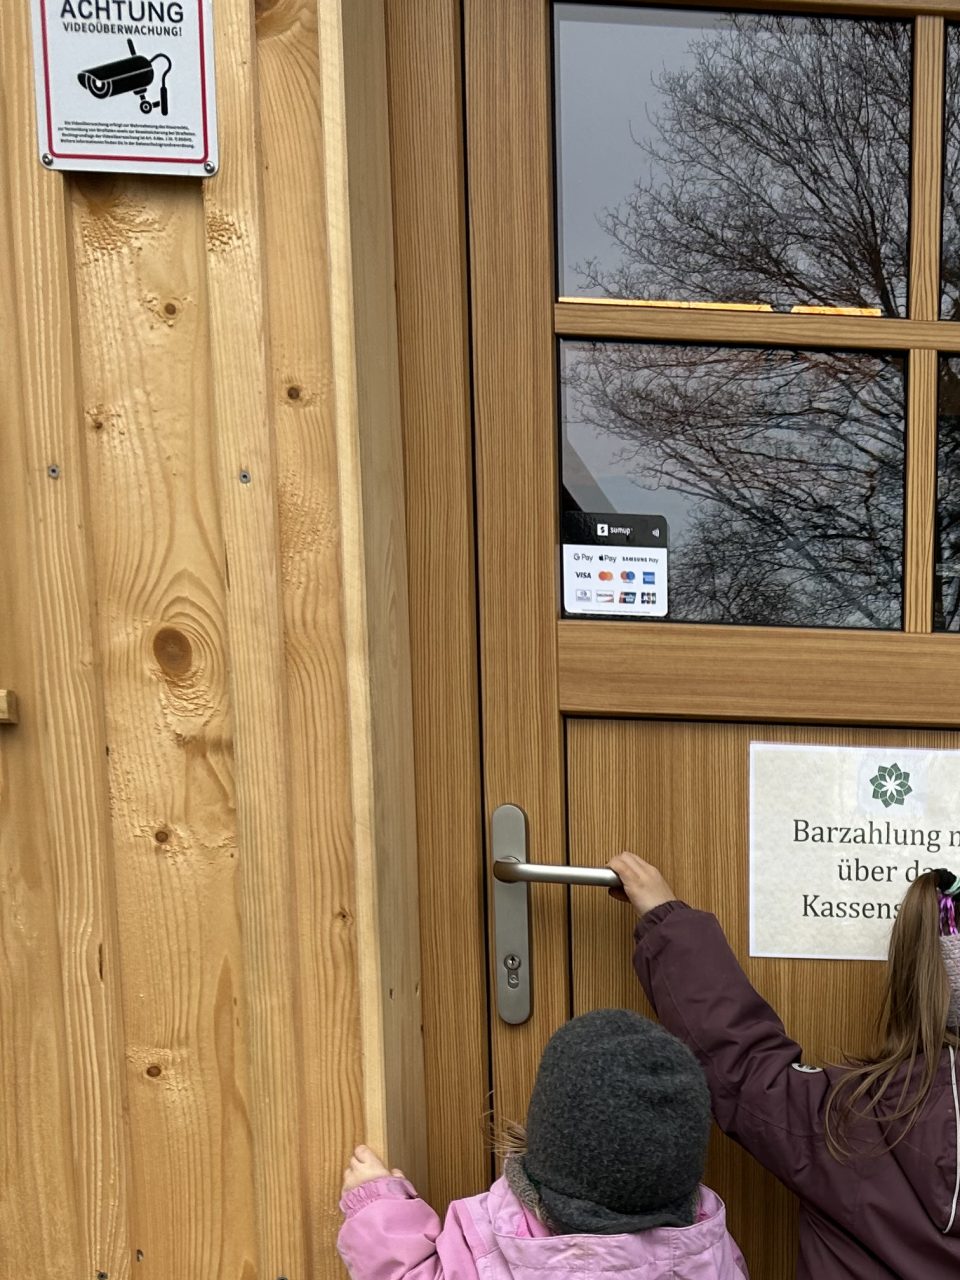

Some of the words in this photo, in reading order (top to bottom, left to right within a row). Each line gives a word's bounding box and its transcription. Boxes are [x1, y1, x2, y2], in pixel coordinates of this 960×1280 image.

[60, 0, 184, 23] ACHTUNG
[63, 21, 183, 37] VIDEOÜBERWACHUNG!
[575, 571, 592, 579] VISA
[792, 818, 942, 853] Barzahlung
[837, 858, 898, 882] über
